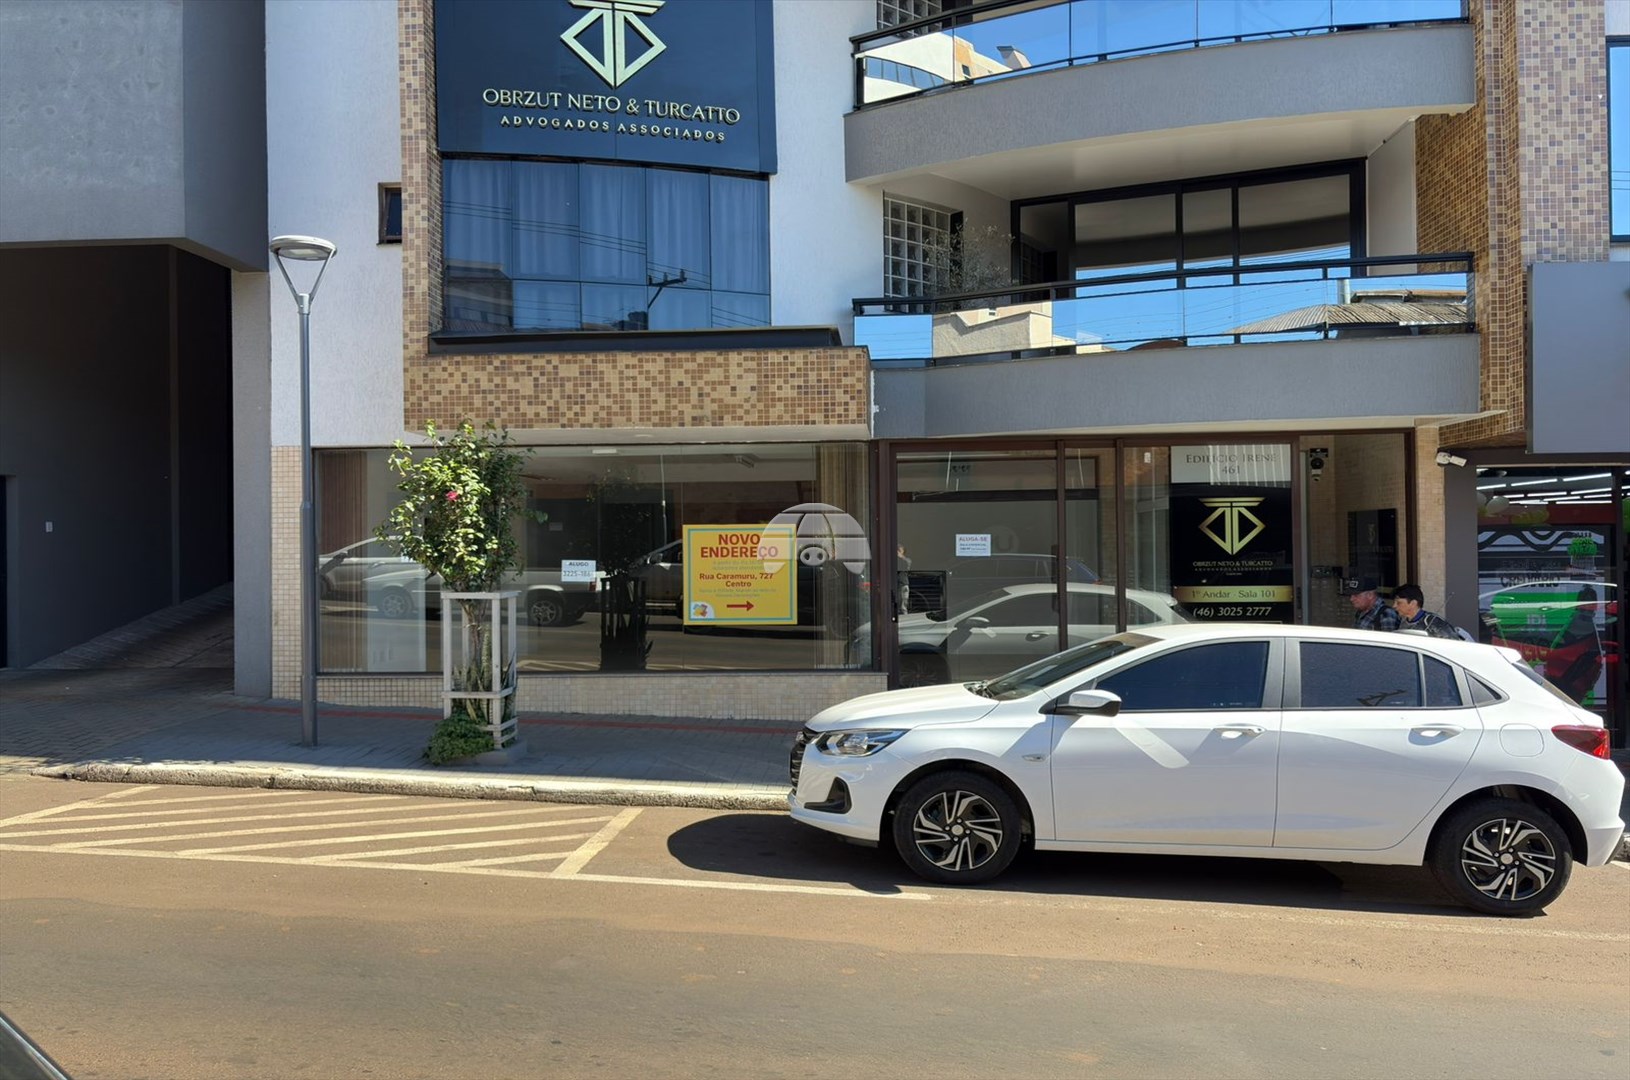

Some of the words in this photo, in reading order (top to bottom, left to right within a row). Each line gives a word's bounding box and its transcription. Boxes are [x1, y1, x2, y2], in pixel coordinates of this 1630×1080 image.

[483, 88, 562, 108] OBRZUT
[568, 93, 621, 112] NETO
[626, 98, 640, 115] &
[645, 99, 741, 124] TURCATTO
[500, 115, 610, 131] ADVOGADOS
[617, 123, 726, 142] ASSOCIADOS
[1242, 454, 1277, 463] IRENE
[1222, 466, 1241, 475] 461
[718, 533, 761, 545] NOVO
[700, 546, 778, 560] ENDEREÇO
[1202, 590, 1230, 598] Andar
[1238, 590, 1257, 598] Sala
[1261, 590, 1276, 598] 101
[1193, 607, 1214, 617] (46)
[1217, 607, 1243, 616] 3025
[1246, 606, 1272, 616] 2777
